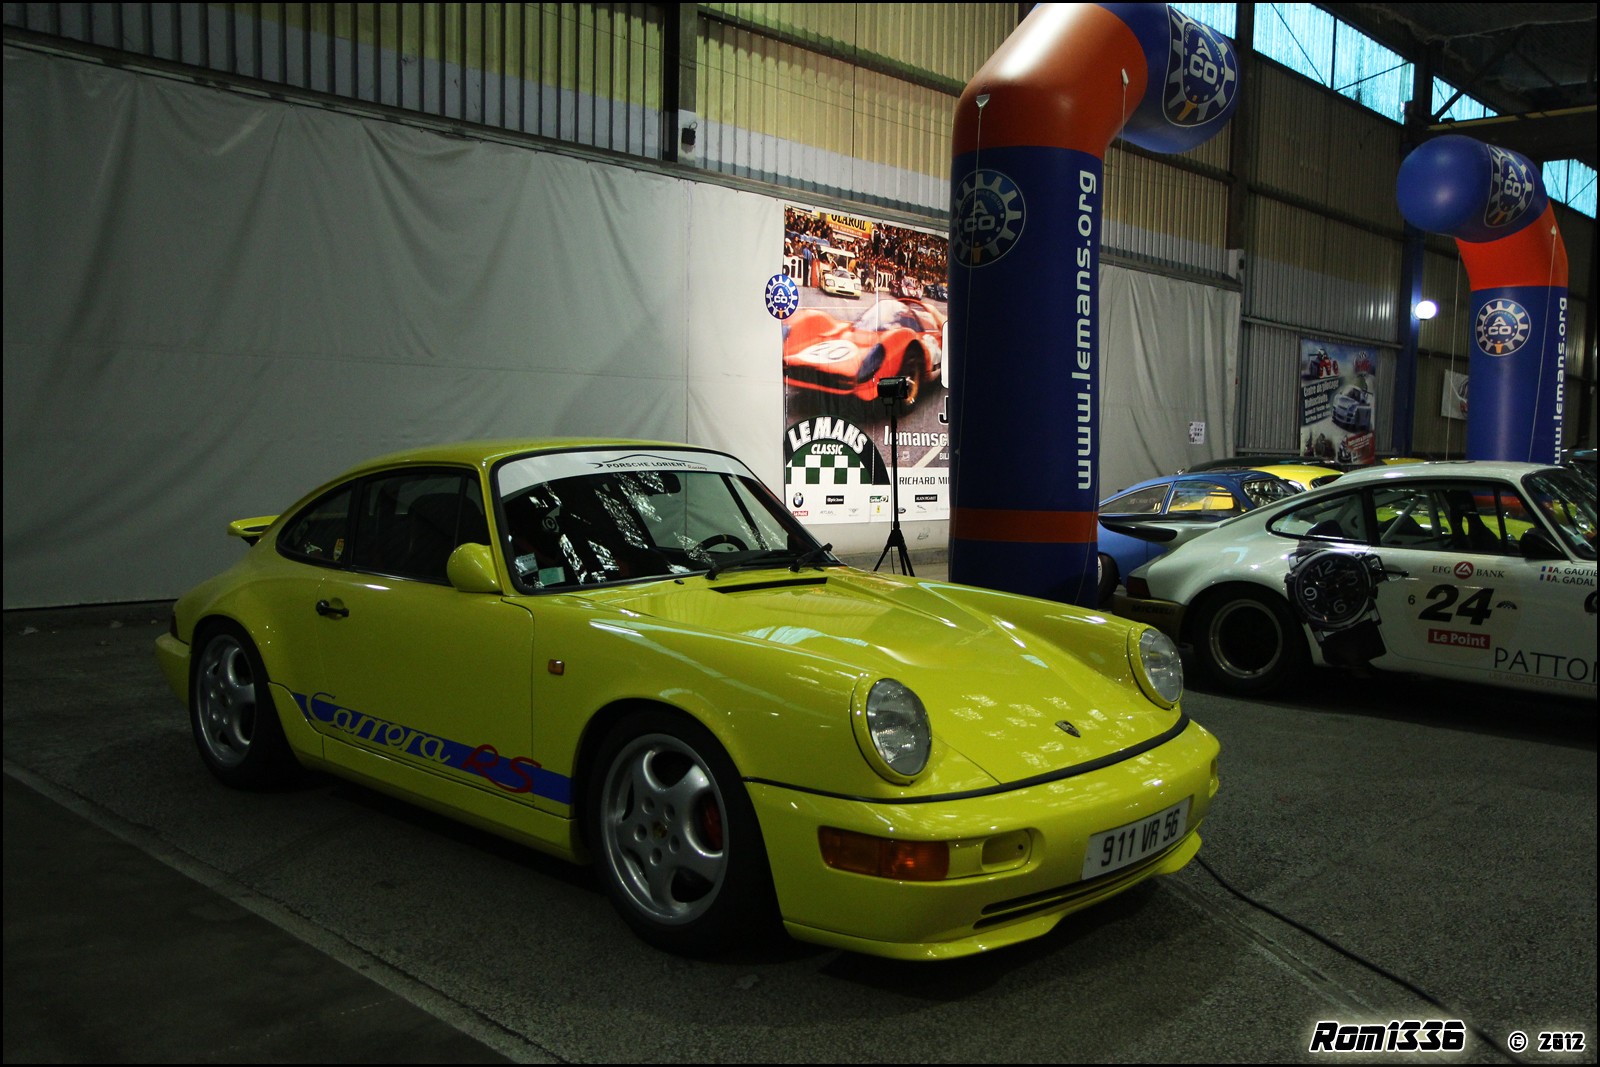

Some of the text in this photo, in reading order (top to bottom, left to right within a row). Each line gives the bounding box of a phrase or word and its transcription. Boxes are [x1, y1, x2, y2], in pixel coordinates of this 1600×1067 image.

[1071, 170, 1096, 489] www.lemans.org
[788, 416, 868, 454] LE MANS
[884, 425, 949, 447] lmansc
[811, 443, 844, 455] CLASSIC
[899, 476, 949, 485] RICHARD MI
[1316, 560, 1336, 577] 12
[1432, 565, 1504, 579] EFG BANK
[1562, 576, 1595, 587] GADAL
[1304, 587, 1318, 601] 9
[1333, 599, 1347, 614] 6
[1408, 583, 1495, 627] 6 24
[1433, 631, 1486, 647] Le Point
[1495, 647, 1597, 682] PATTO
[306, 692, 542, 793] Carrera RS
[1101, 808, 1180, 867] 911 VR 56
